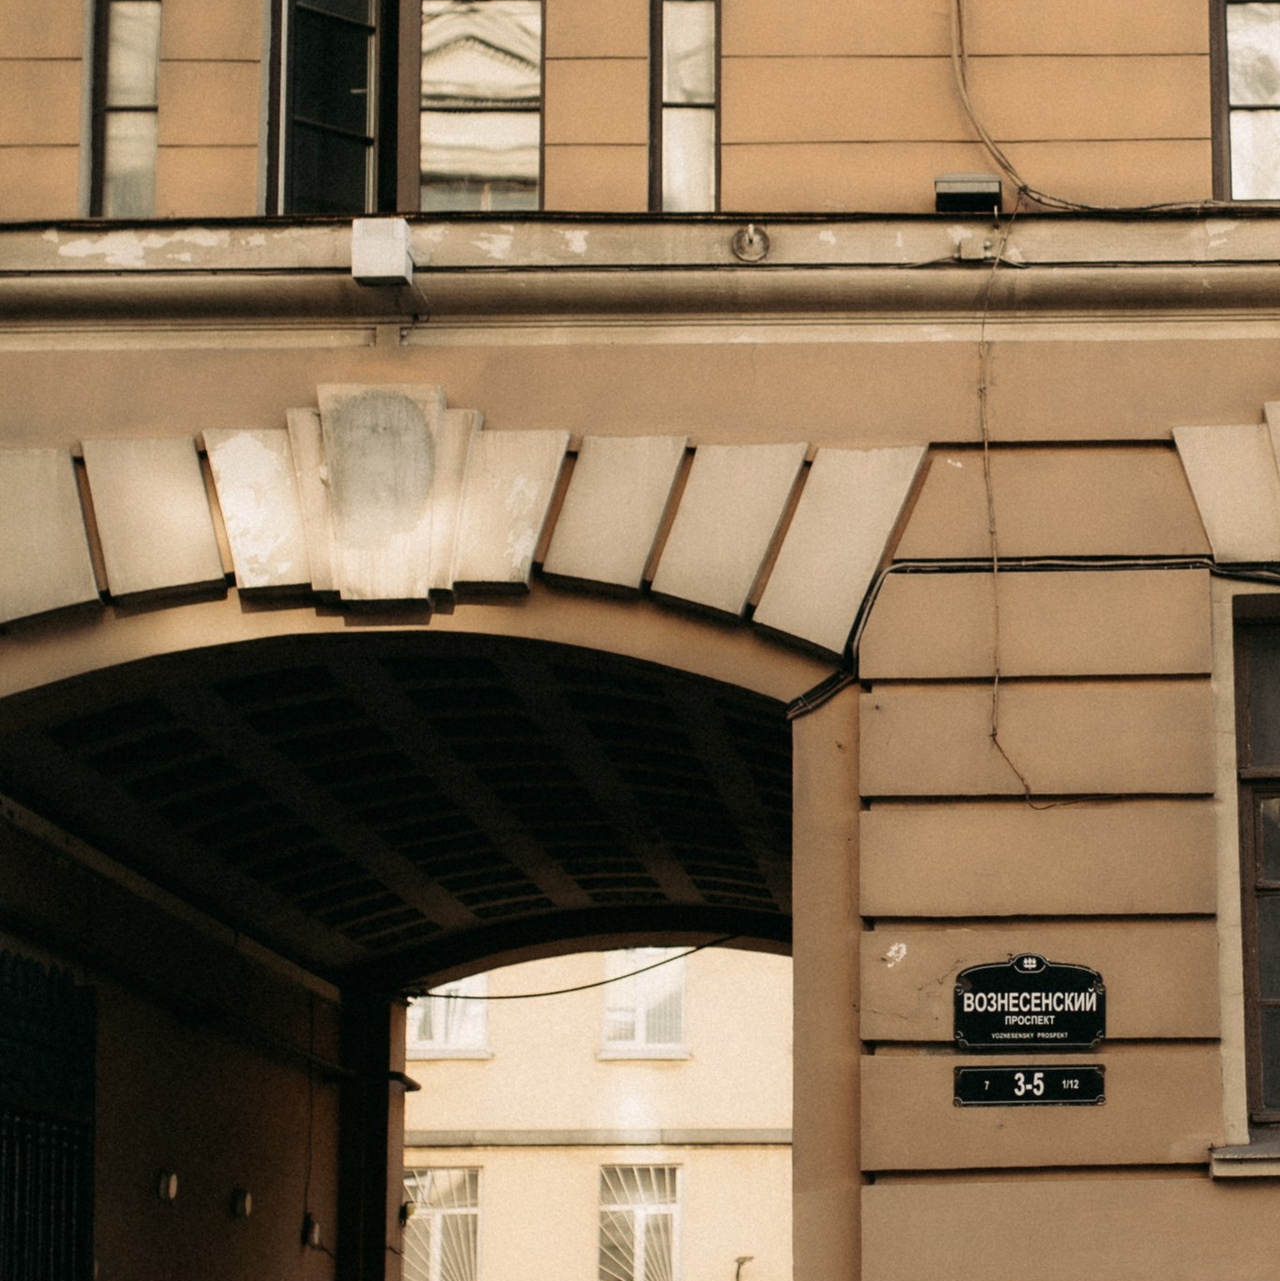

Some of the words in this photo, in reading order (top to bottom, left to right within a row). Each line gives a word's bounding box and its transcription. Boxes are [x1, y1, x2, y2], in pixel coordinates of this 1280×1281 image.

[963, 987, 1097, 1012] ВОЗНЕСЕНСКИЙ
[1004, 1015, 1056, 1025] ПРОСПЕКТ
[984, 1080, 990, 1090] 7
[1014, 1072, 1044, 1096] 3-5
[1062, 1079, 1079, 1090] 1/12
